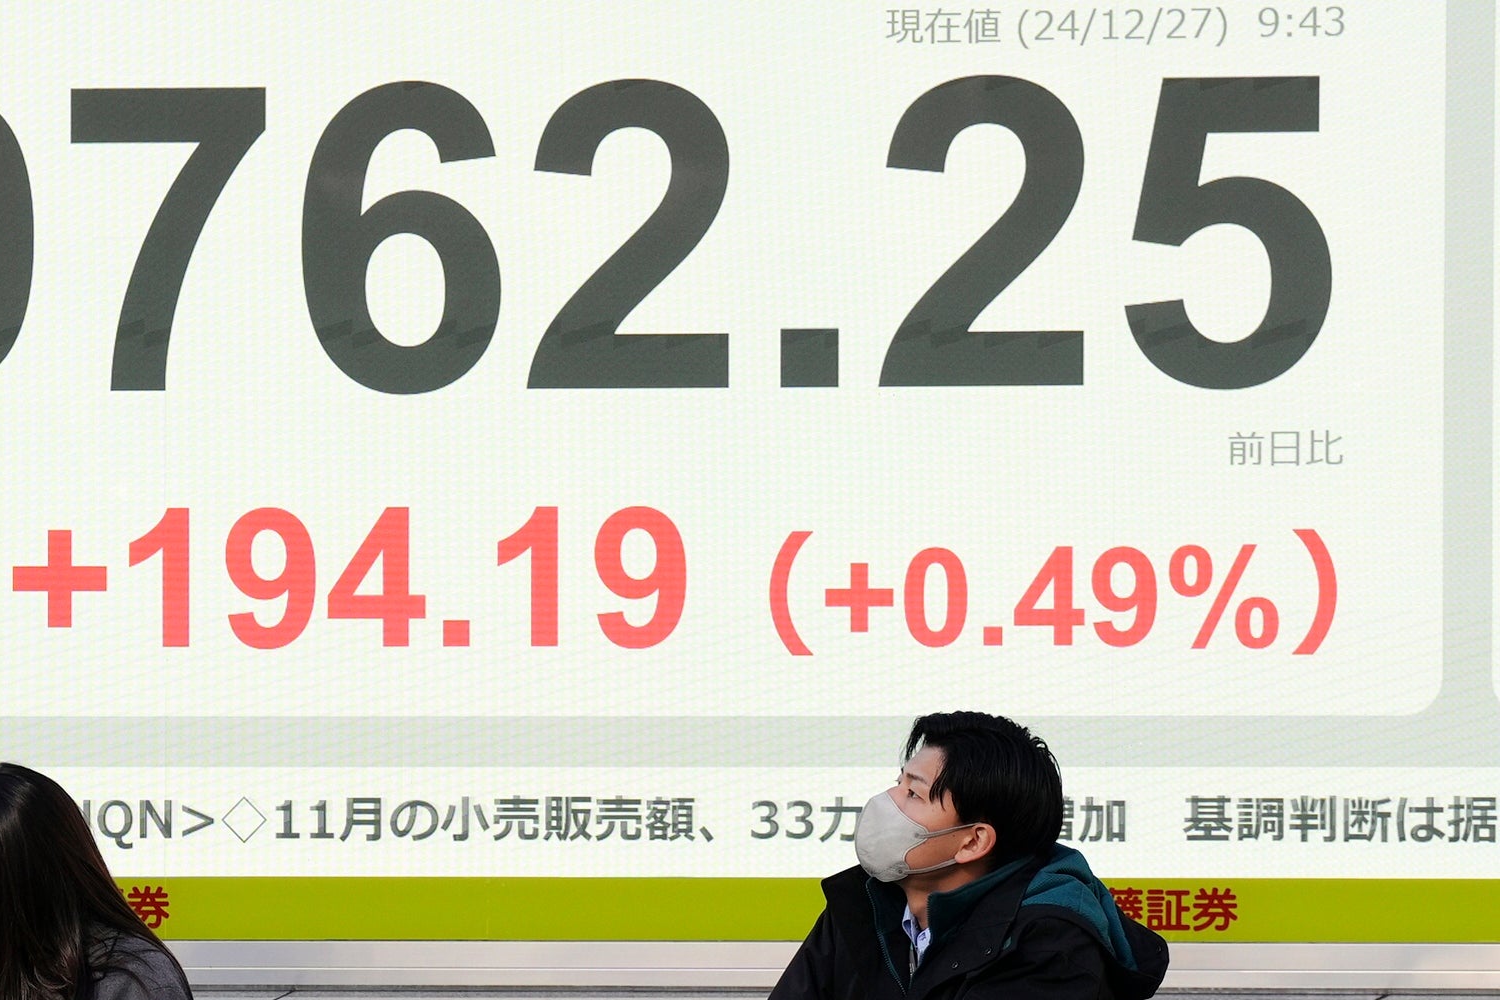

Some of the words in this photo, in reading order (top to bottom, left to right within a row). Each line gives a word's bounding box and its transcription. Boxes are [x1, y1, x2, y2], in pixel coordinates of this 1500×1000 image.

[885, 7, 1001, 45] 現在値
[1017, 6, 1229, 49] (24/12/27)
[1257, 6, 1346, 39] 9:43
[1228, 429, 1345, 467] 前日比
[13, 506, 686, 649] +194.19
[770, 529, 1337, 656] (+0.49%)
[1183, 794, 1497, 843] 基調判断は据
